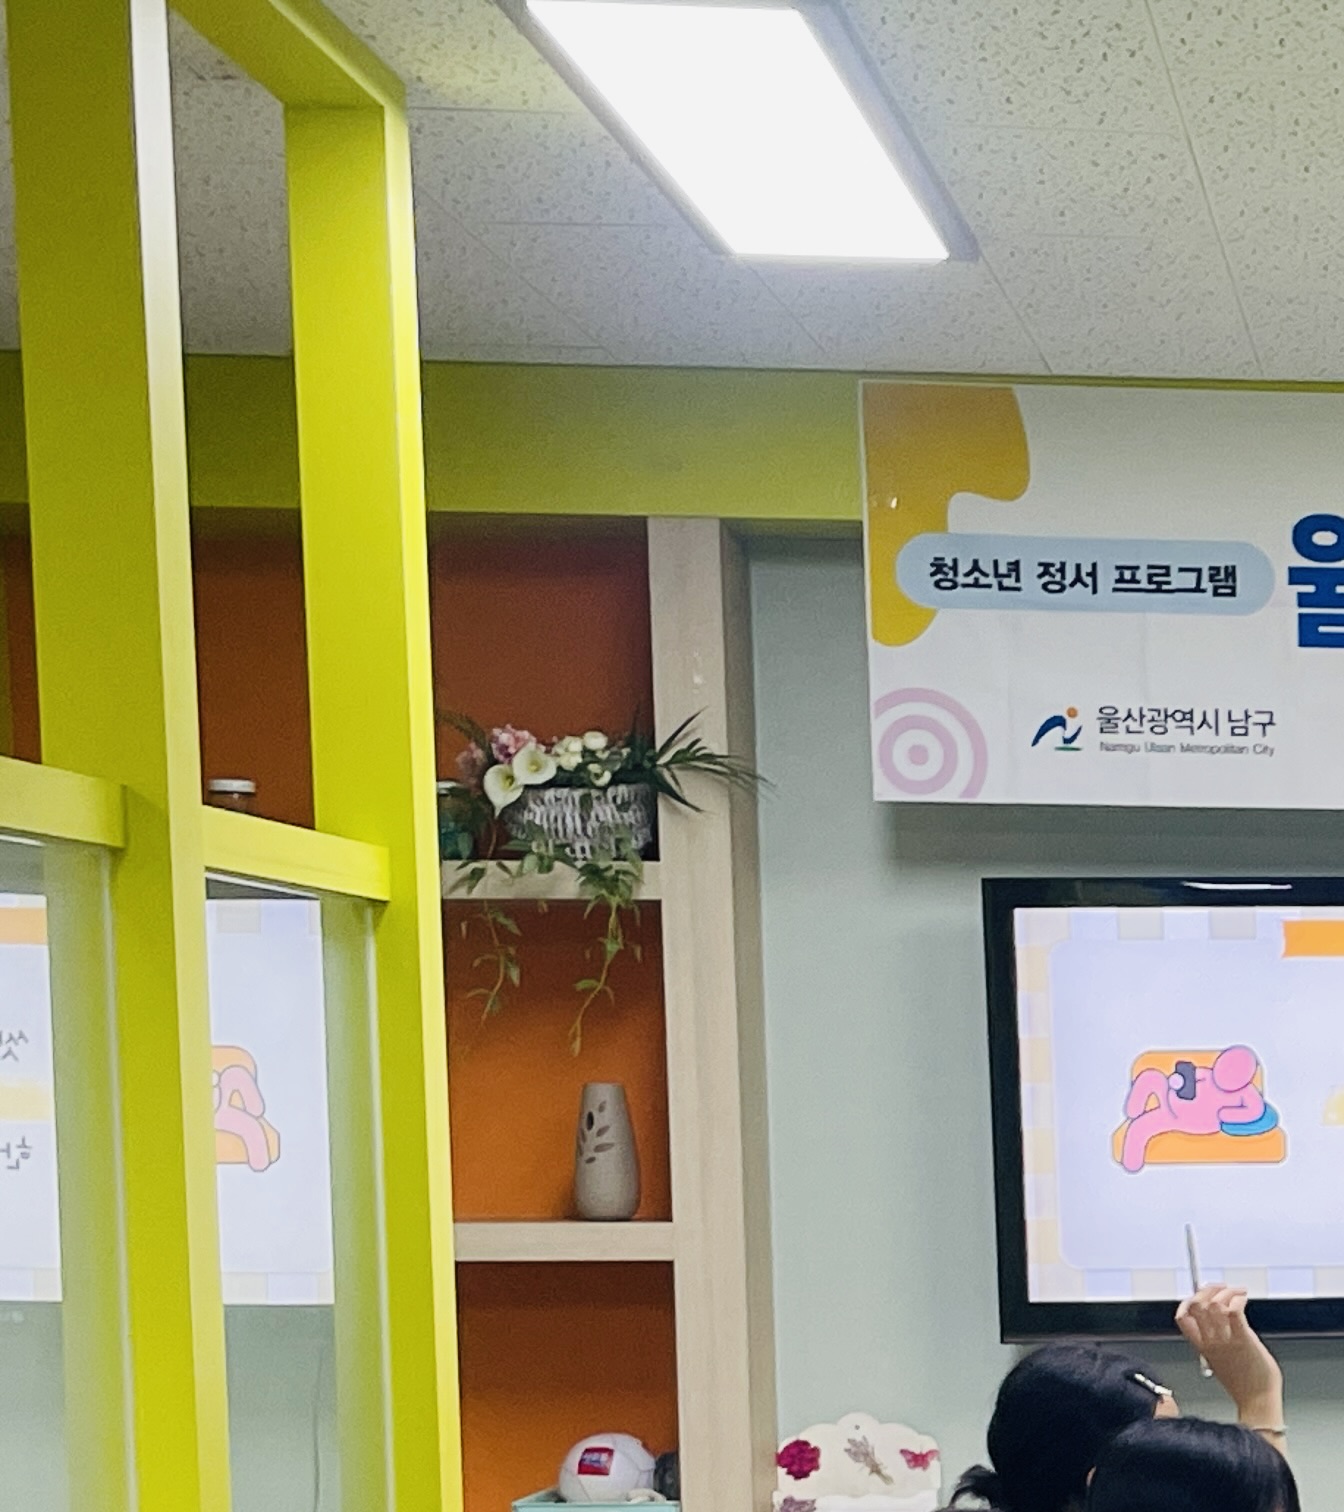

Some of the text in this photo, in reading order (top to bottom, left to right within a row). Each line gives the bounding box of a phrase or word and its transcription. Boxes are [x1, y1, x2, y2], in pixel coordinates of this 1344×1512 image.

[928, 556, 1238, 597] 청소년 정서 프로그램
[1096, 705, 1276, 738] 울산광역시 남구
[1179, 742, 1250, 756] Metropolitan
[1252, 743, 1276, 757] City
